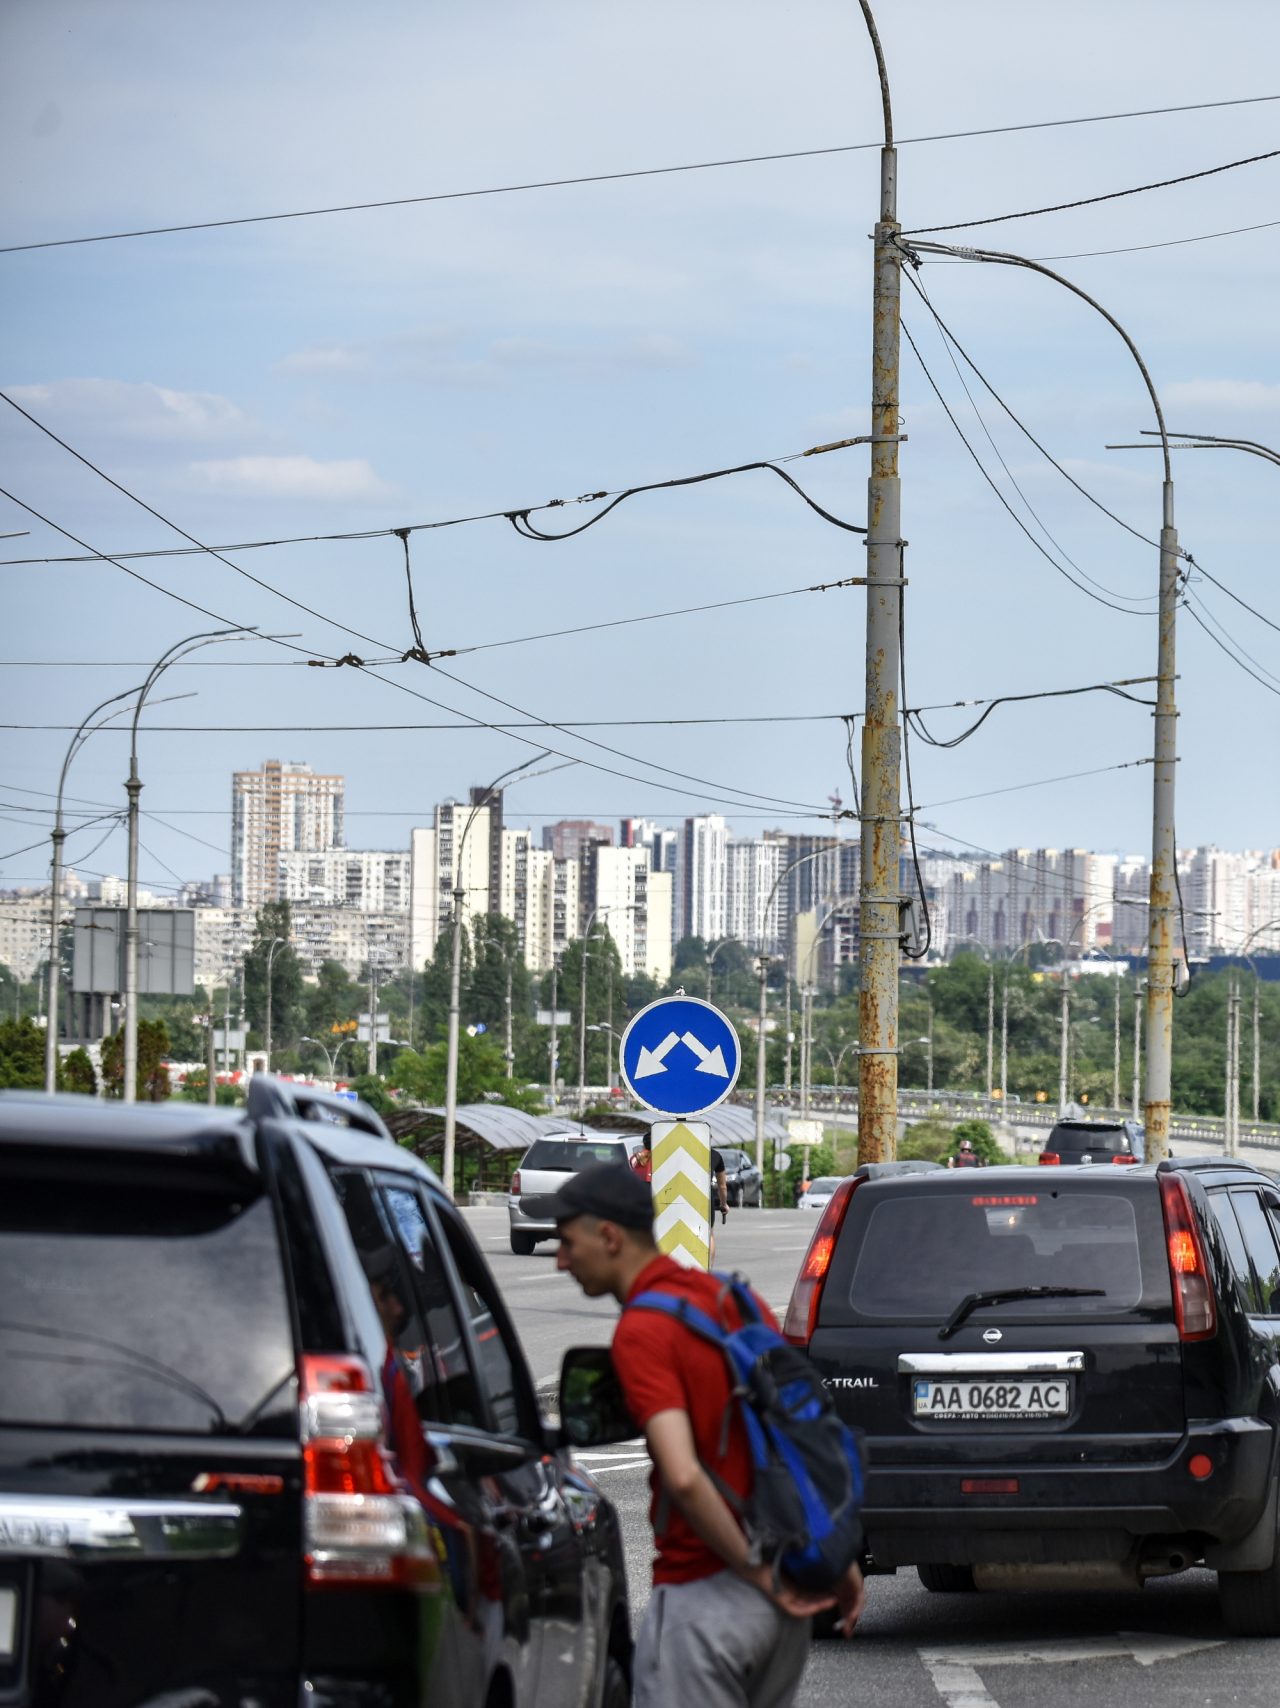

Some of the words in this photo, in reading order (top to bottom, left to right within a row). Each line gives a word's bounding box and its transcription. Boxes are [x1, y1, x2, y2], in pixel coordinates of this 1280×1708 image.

[931, 1386, 963, 1409] AA
[968, 1385, 1022, 1409] 0682
[1027, 1385, 1061, 1409] AC
